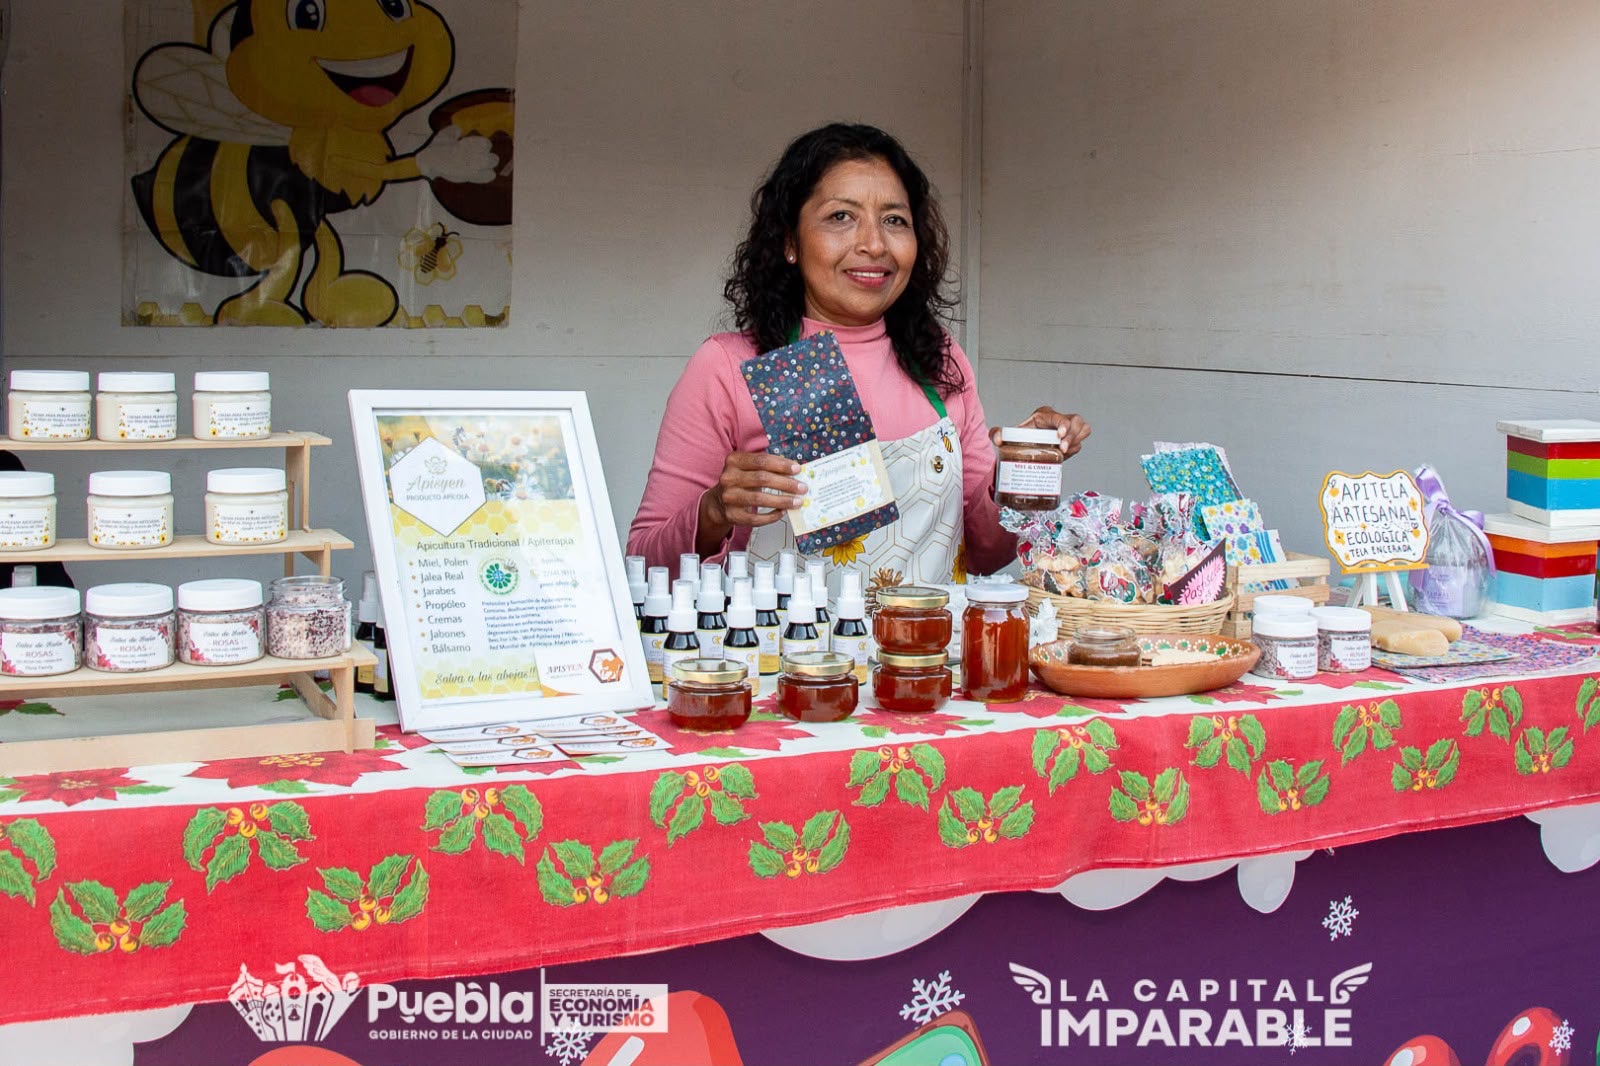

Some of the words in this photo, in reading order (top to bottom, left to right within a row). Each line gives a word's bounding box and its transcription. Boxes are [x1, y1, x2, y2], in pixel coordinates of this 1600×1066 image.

[1342, 482, 1409, 501] APITELA
[1332, 505, 1416, 523] ARTESANAL
[417, 541, 466, 552] Apicultura
[468, 539, 520, 550] Tradicional
[528, 537, 575, 548] Apiterapia
[1349, 548, 1368, 558] TELA
[1371, 544, 1412, 554] ENCERADA
[418, 558, 442, 568] Miel,
[444, 558, 468, 566] Polen
[420, 574, 443, 584] Jalea
[444, 572, 464, 580] Real
[423, 587, 456, 598] Jarabes
[426, 600, 466, 612] Propóleo
[428, 615, 463, 624] Cremas
[430, 629, 466, 641] Jabones
[26, 650, 53, 658] ROSAS
[120, 644, 146, 652] ROSAS
[432, 643, 471, 654] Bálsamo
[435, 672, 464, 684] Salva
[478, 671, 492, 682] las
